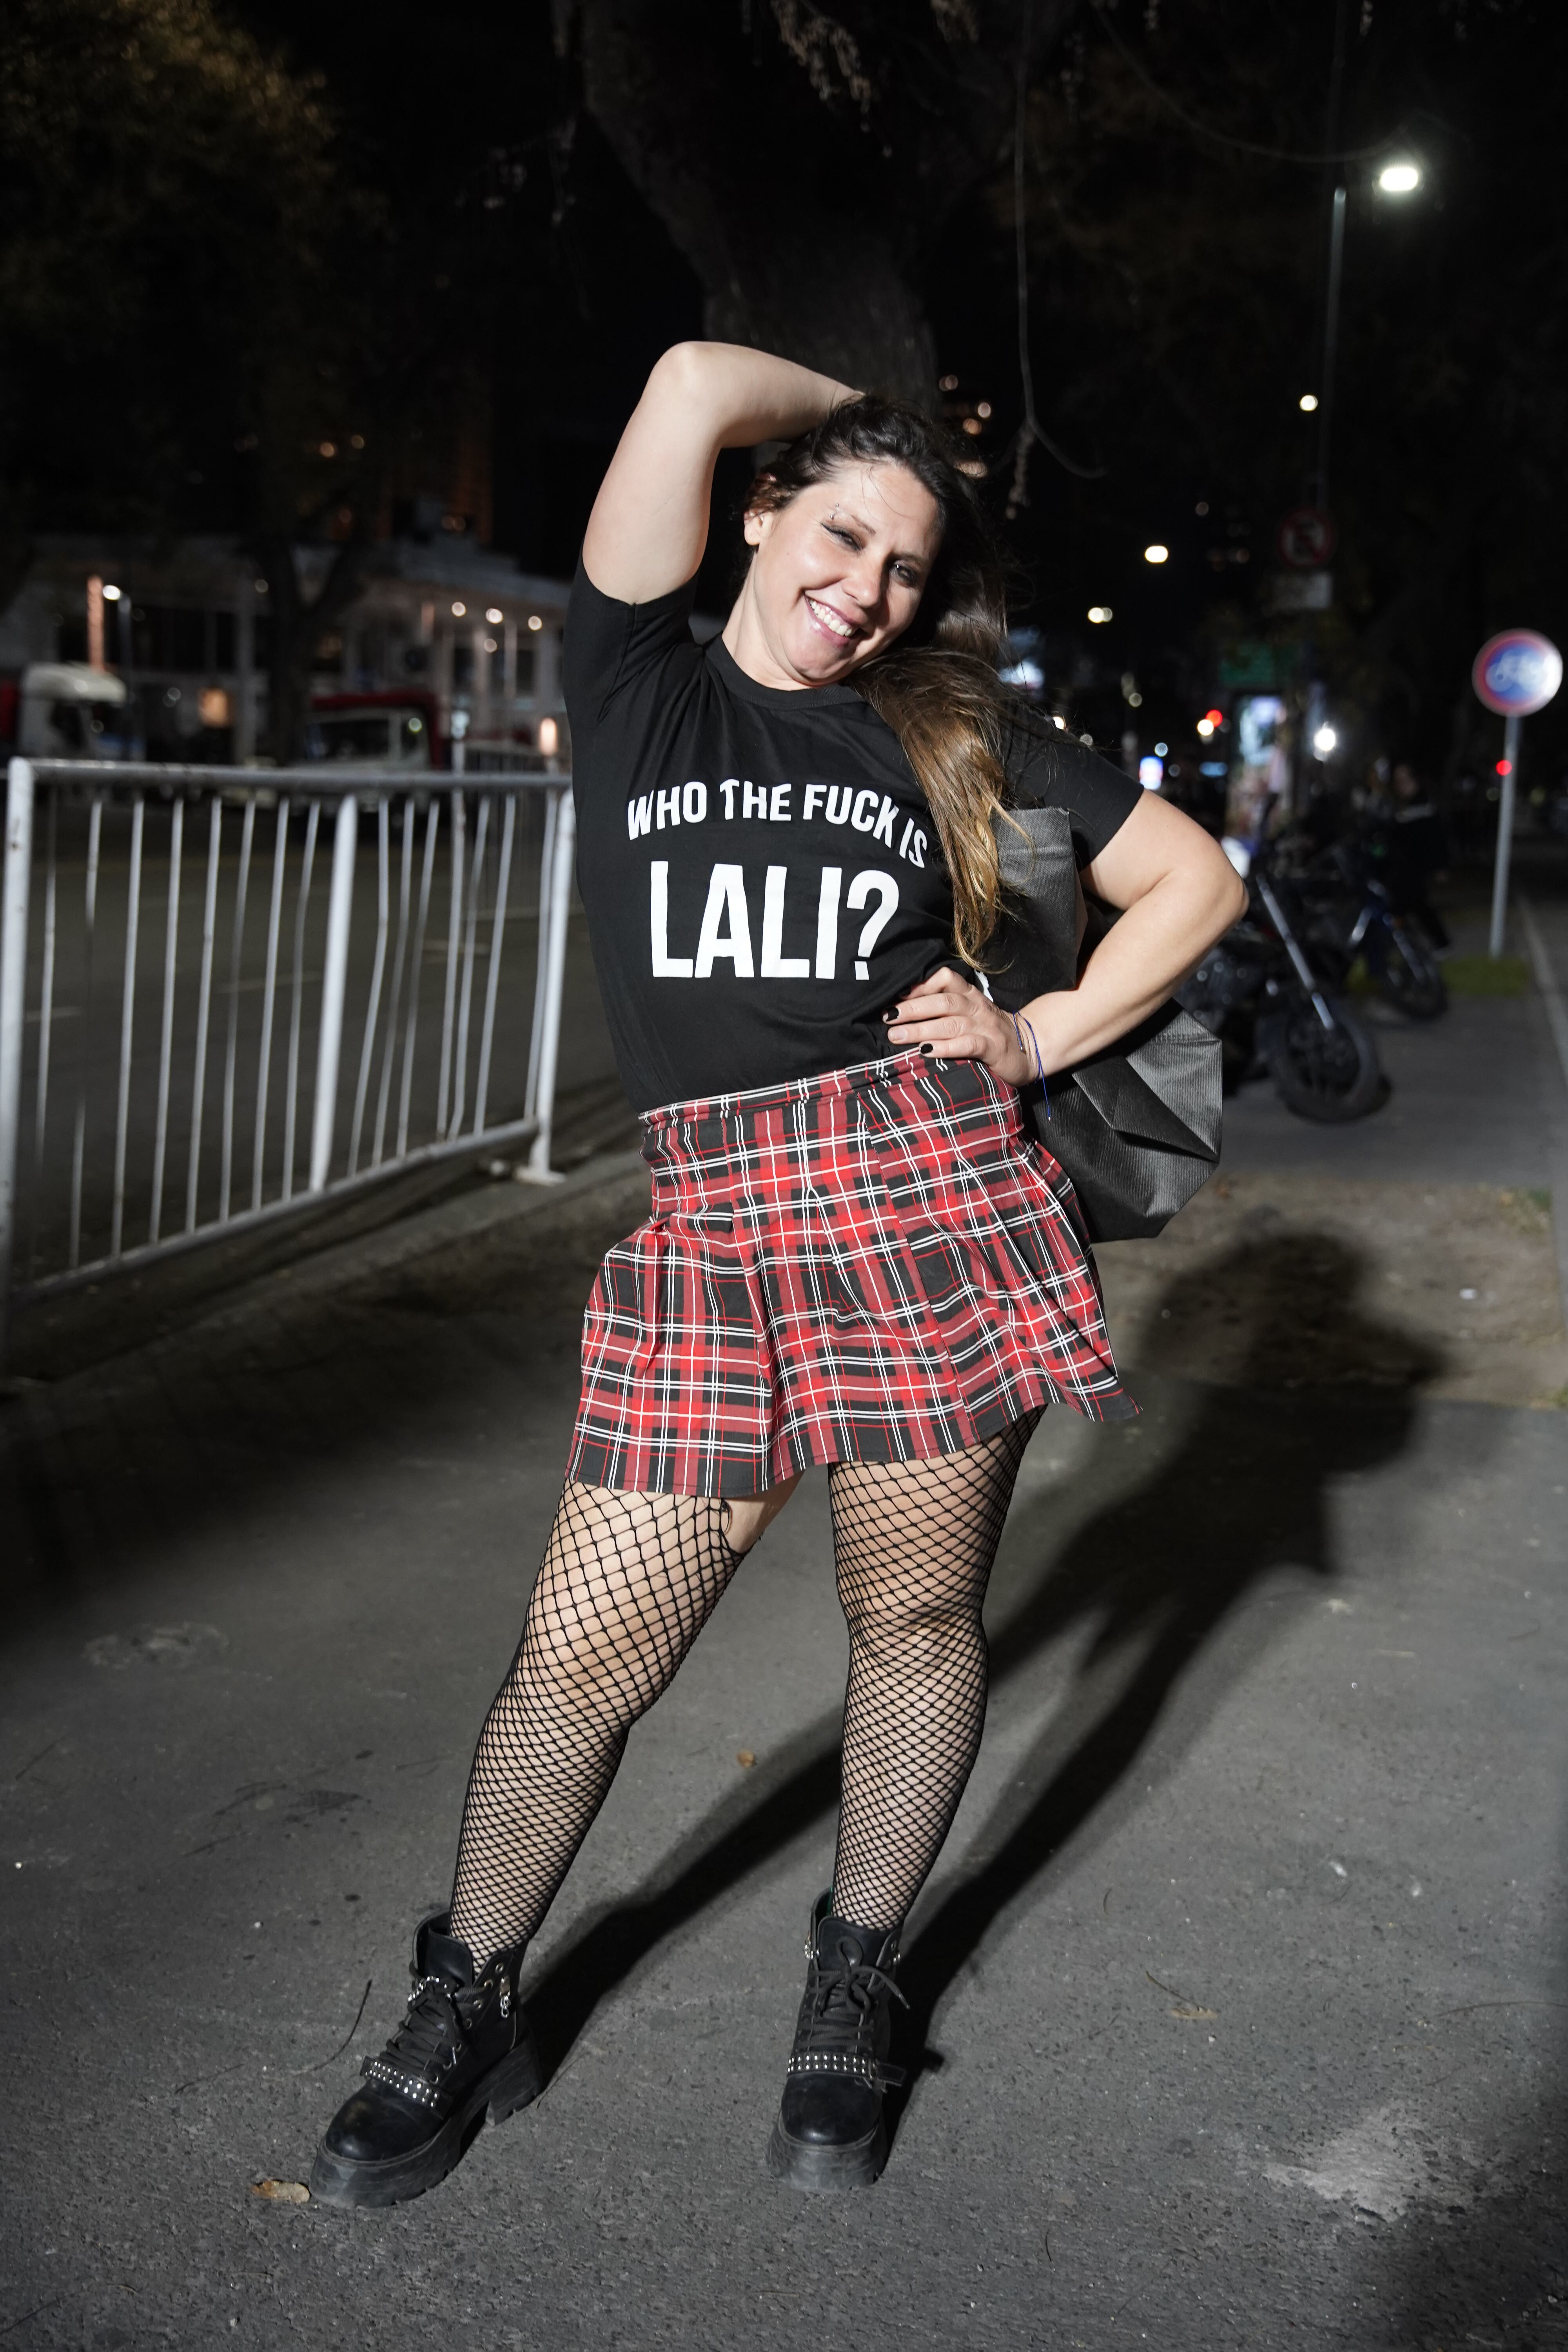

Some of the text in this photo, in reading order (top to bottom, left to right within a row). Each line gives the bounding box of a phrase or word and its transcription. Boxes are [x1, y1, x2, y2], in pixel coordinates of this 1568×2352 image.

[628, 779, 927, 868] WHO THE FUCK IS
[651, 861, 899, 980] LALI?
